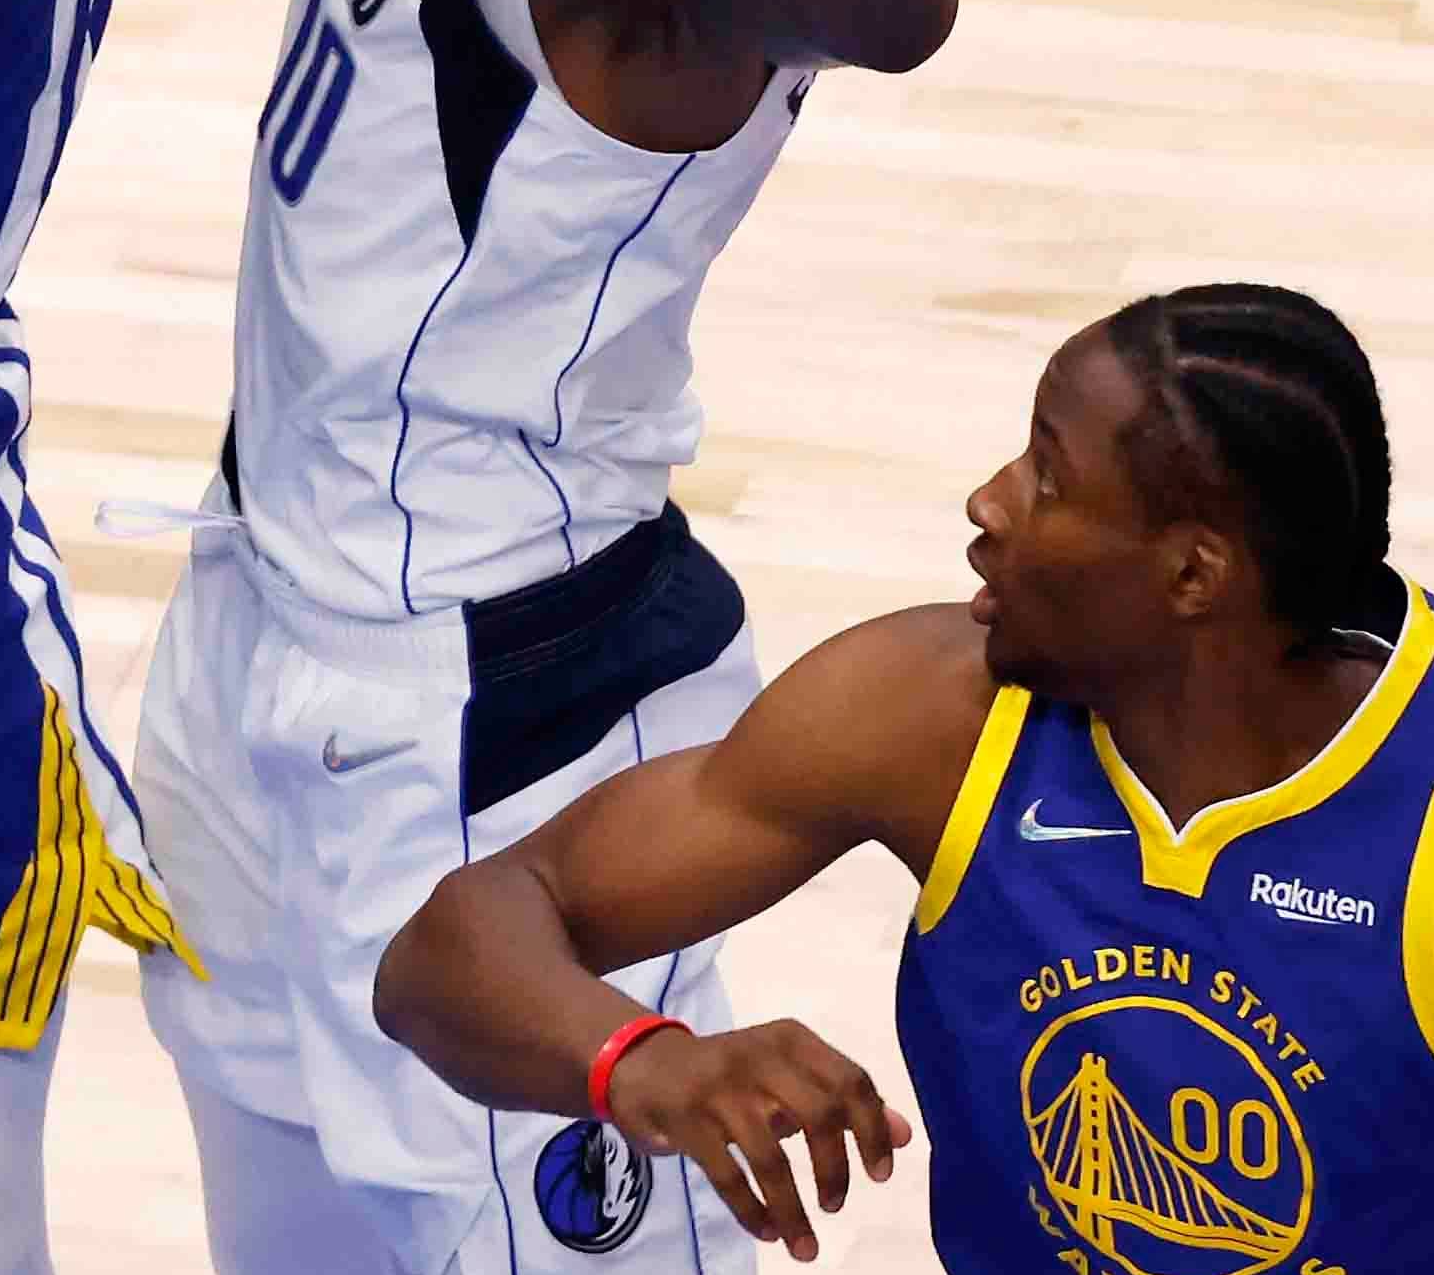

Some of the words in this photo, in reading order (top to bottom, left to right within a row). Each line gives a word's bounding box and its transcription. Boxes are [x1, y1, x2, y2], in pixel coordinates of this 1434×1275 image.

[1250, 872, 1376, 926] Rakuten
[1019, 944, 1192, 1013] GOLDEN
[1209, 969, 1327, 1092] STATE
[1169, 1086, 1280, 1181] 00
